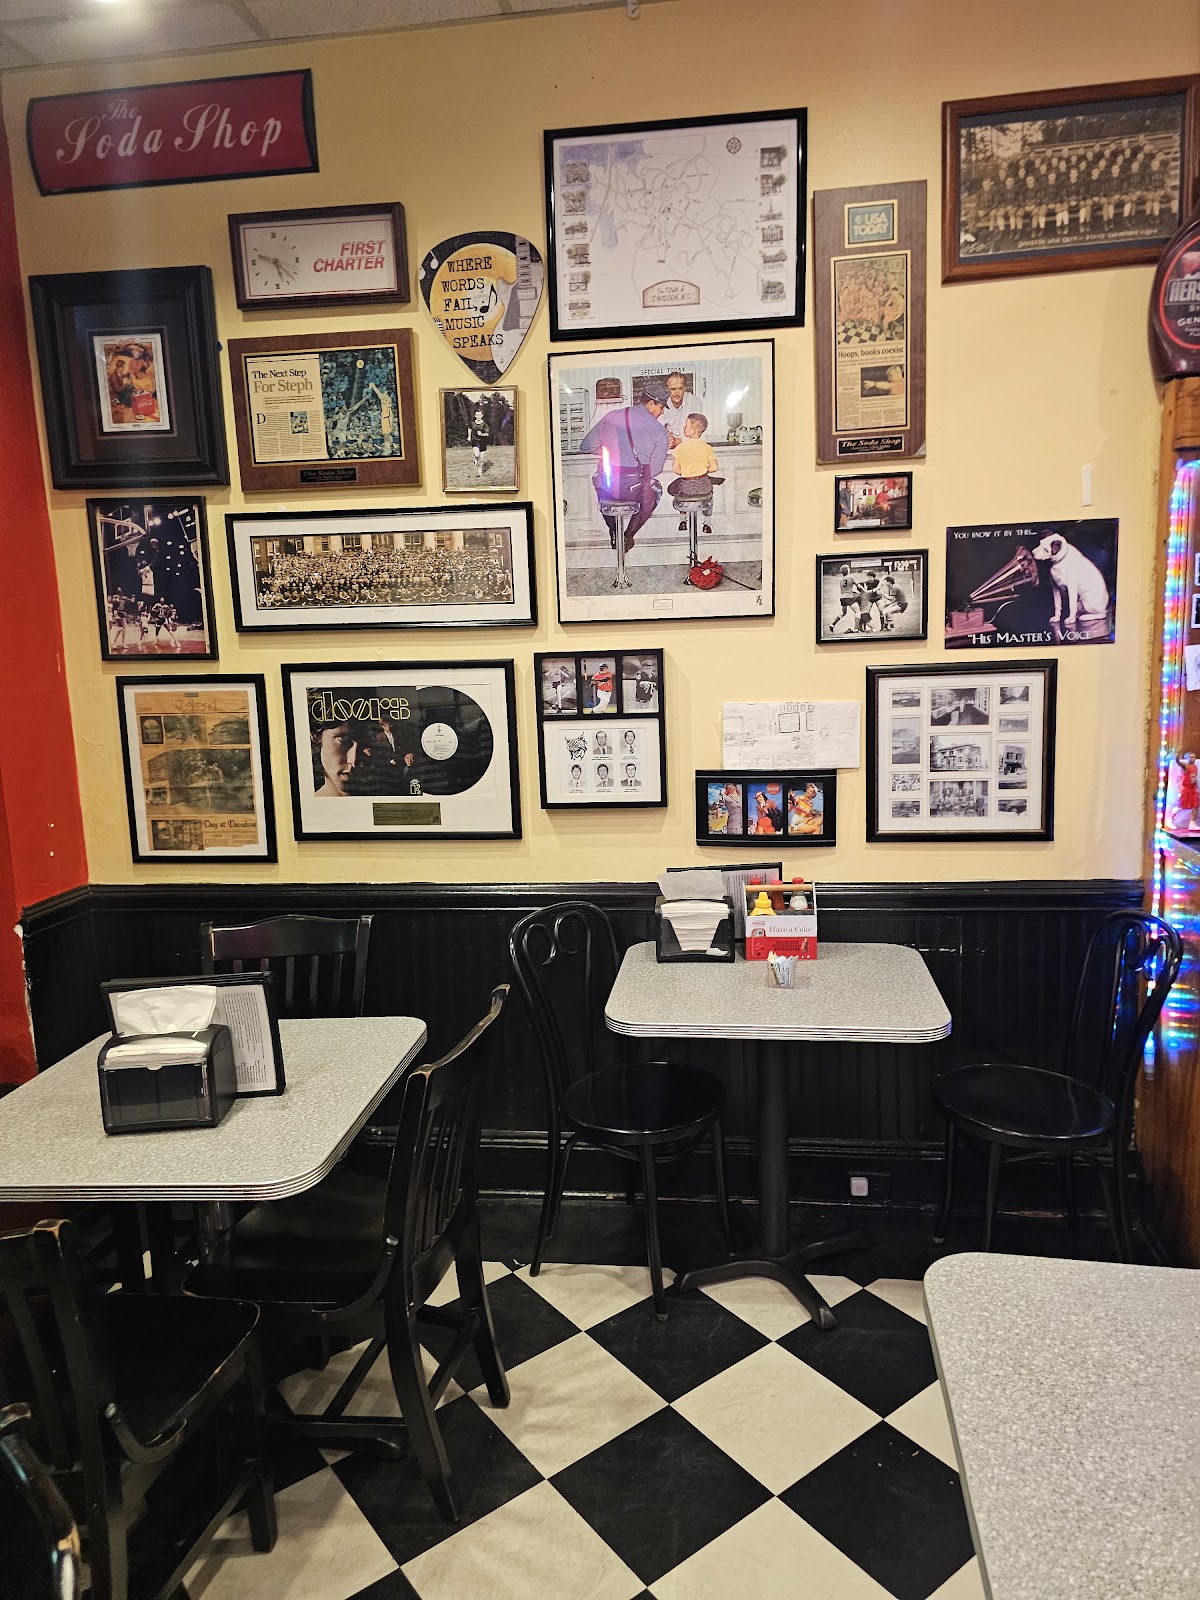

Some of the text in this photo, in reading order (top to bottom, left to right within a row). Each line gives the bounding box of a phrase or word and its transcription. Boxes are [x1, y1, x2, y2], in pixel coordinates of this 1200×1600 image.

[101, 99, 138, 121] The
[56, 104, 282, 163] Soda Shop
[865, 212, 888, 224] USA
[853, 222, 890, 236] TODAY
[340, 240, 386, 256] FIRST
[313, 255, 385, 272] CHARTER
[447, 256, 492, 272] WHERE
[441, 278, 485, 293] WORDS
[444, 298, 478, 312] FAIL,
[444, 316, 485, 330] MUSIC
[454, 334, 504, 349] SPEAKS
[861, 348, 880, 356] books
[882, 346, 904, 354] coexist
[252, 369, 306, 379] The Next Step
[254, 378, 314, 393] For Steph
[996, 630, 1052, 644] MASTER'S
[203, 820, 218, 830] Day
[228, 820, 256, 828] Davidson
